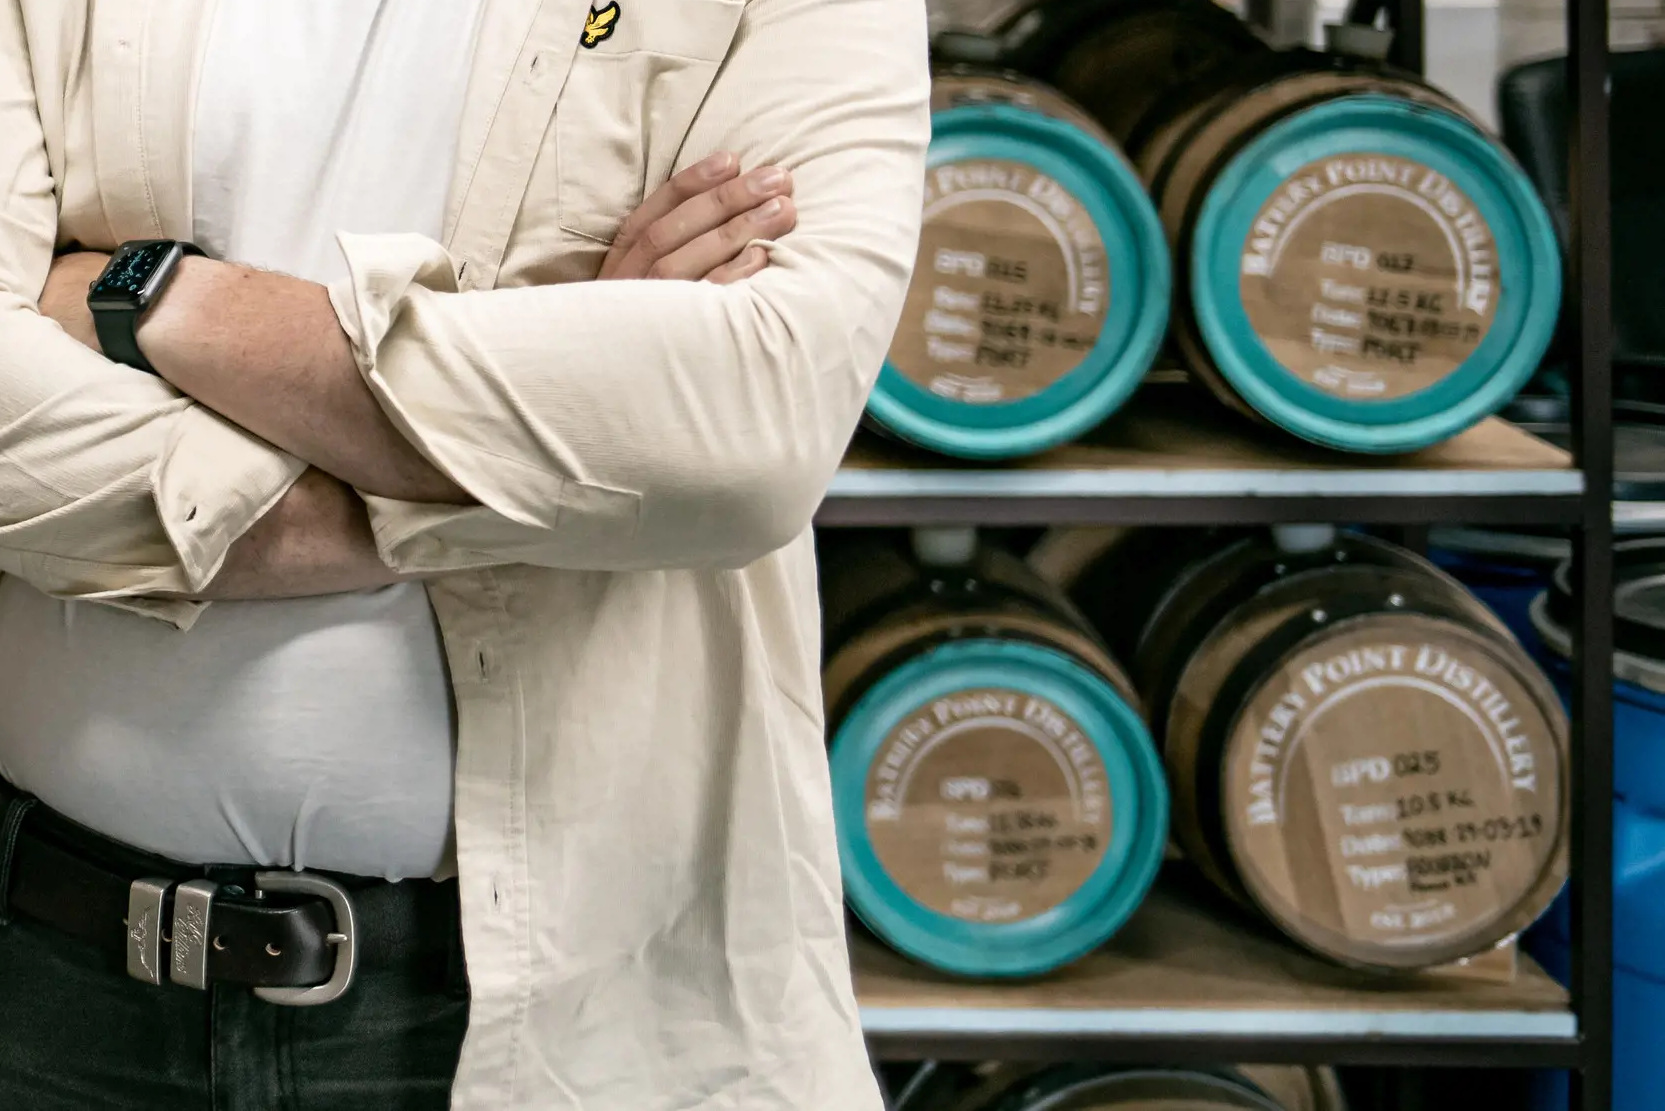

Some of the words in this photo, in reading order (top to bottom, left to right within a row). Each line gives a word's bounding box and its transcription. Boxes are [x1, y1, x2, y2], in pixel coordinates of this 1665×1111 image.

[1324, 156, 1413, 185] POINT
[1245, 690, 1308, 826] BATTERY
[1300, 644, 1411, 697] POINT
[1413, 642, 1538, 793] DISTILLERY
